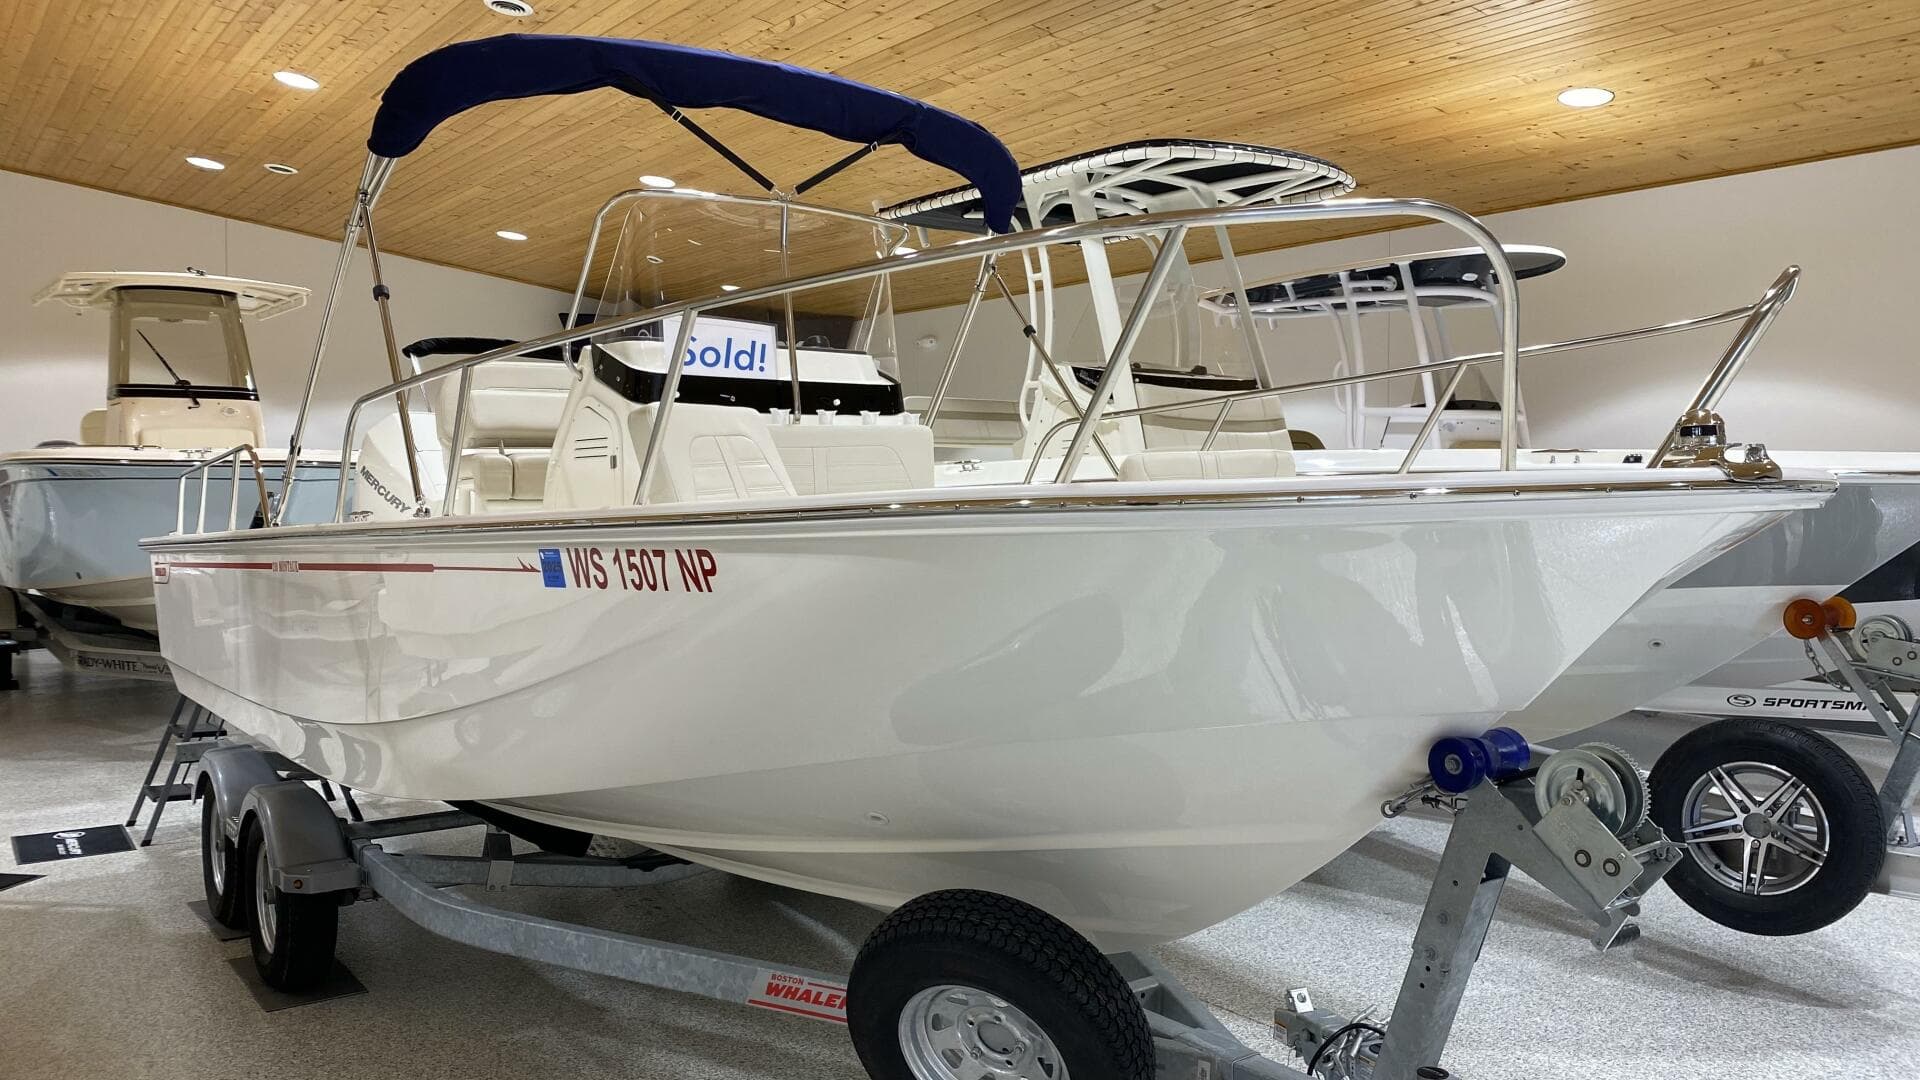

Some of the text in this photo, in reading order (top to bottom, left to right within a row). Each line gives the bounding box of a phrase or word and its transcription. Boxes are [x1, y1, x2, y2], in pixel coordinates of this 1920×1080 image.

[360, 466, 411, 513] MERCURY
[566, 547, 608, 590] WS
[613, 548, 670, 592] 1507
[675, 548, 718, 593] NP
[1763, 697, 1891, 711] SPORTSM
[771, 974, 804, 985] BOSTON
